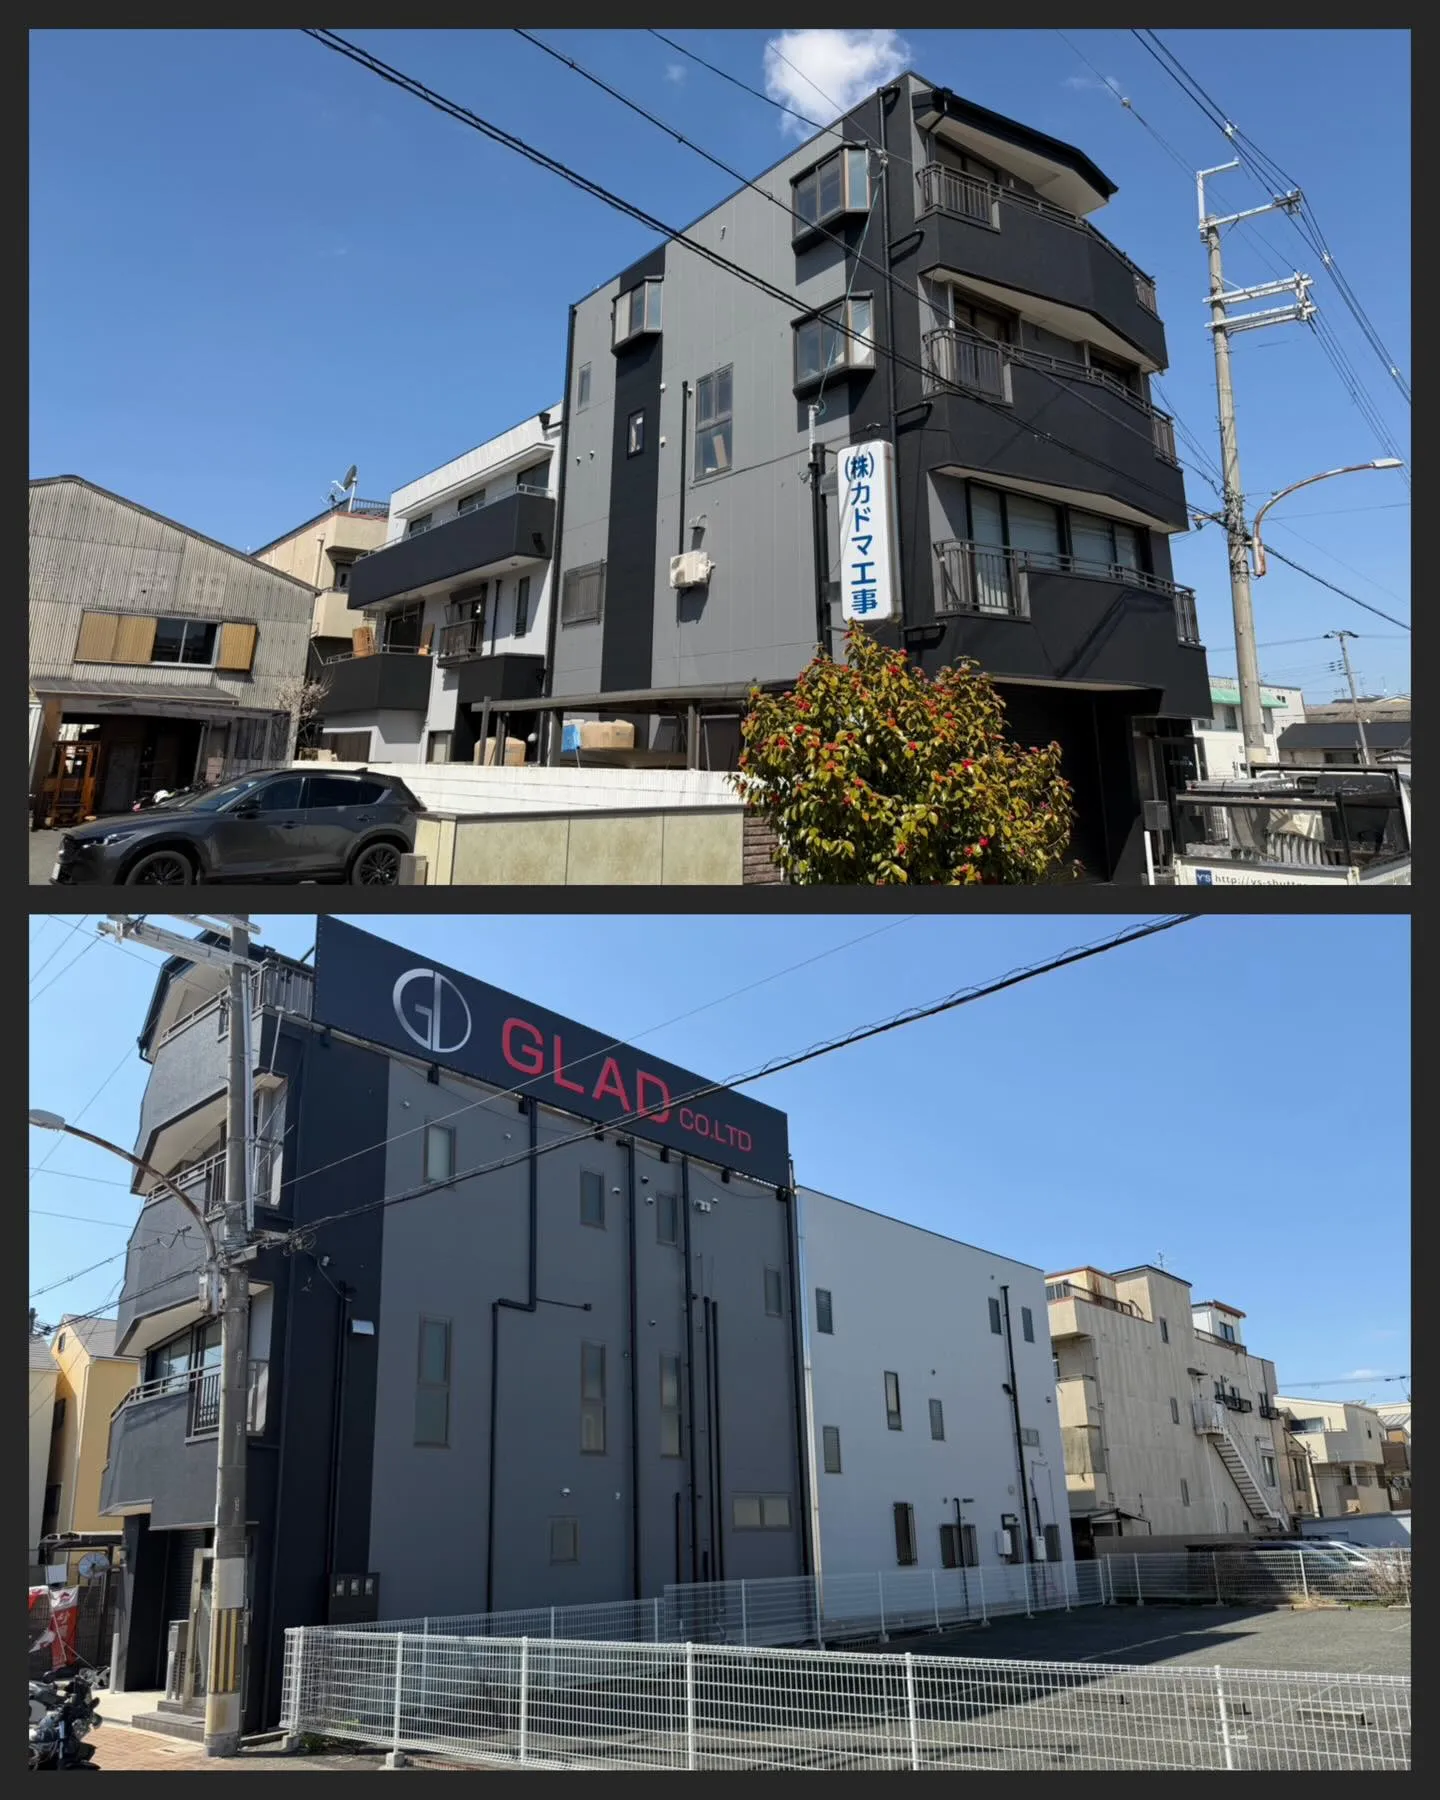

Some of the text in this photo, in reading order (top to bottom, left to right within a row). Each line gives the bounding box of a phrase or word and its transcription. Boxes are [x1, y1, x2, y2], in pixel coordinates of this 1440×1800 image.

[844, 451, 878, 615] (株)カドマ工事
[501, 1016, 753, 1153] GLAD CO.LTD
